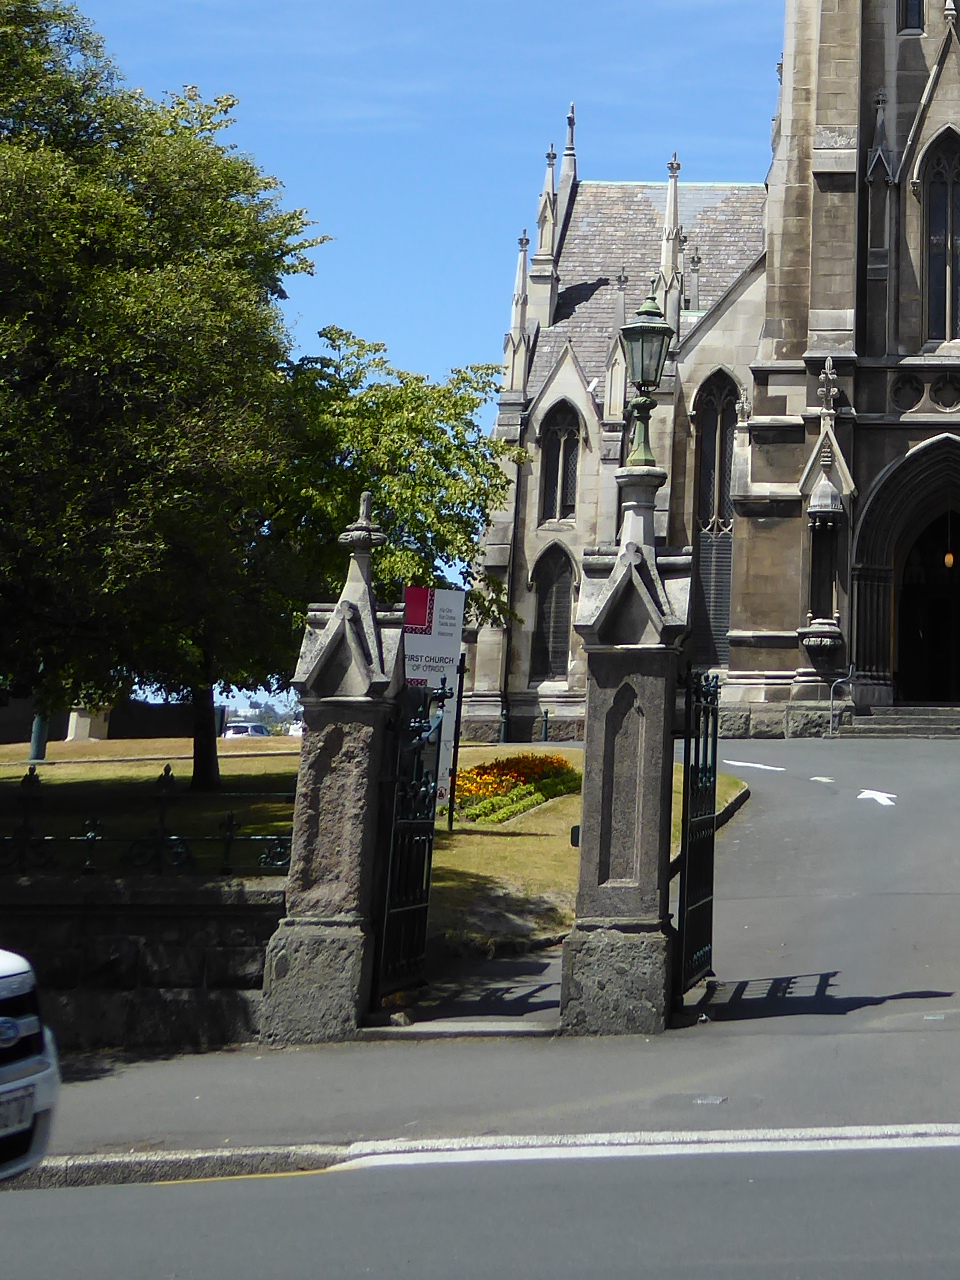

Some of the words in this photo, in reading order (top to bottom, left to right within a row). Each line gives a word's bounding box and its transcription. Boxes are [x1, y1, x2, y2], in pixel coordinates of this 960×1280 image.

[405, 654, 424, 663] FIRST
[424, 655, 454, 664] CHURCH
[412, 664, 421, 672] OF
[422, 664, 445, 673] OTAGO
